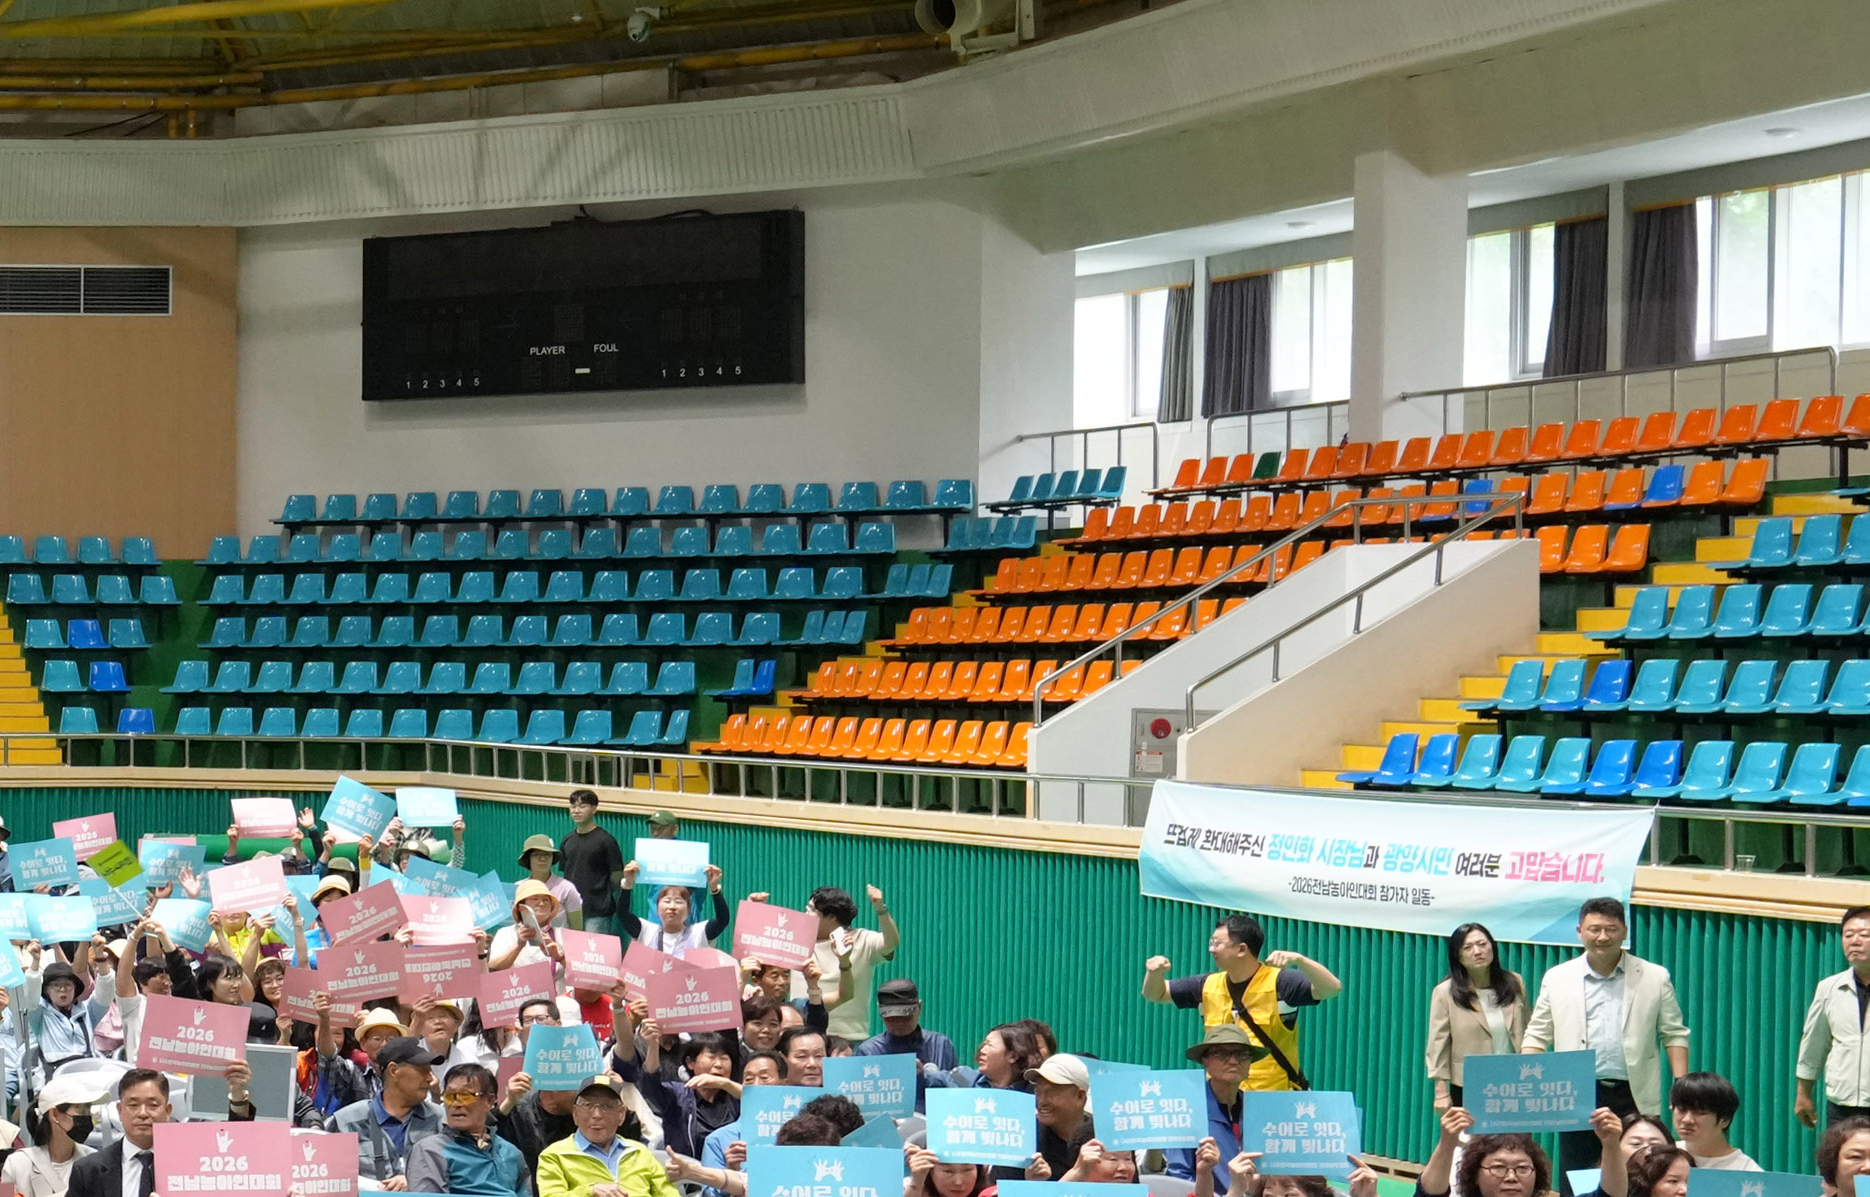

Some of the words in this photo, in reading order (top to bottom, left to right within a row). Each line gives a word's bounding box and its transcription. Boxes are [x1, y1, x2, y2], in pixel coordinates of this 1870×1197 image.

[530, 345, 566, 356] PLAYER
[594, 343, 619, 353] FOUL
[1164, 823, 1201, 848] 뜨겁게
[1199, 828, 1265, 858] 환대해주신
[1267, 833, 1313, 864] 정인화
[1315, 838, 1380, 869] 시장님과
[1383, 841, 1456, 876] 광양시민
[1455, 852, 1502, 878] 여러분
[1505, 851, 1605, 884] 고맙습니다.
[1379, 885, 1409, 904] 참가자
[199, 1156, 248, 1173] 2026
[167, 1174, 282, 1192] 전남농아인대회
